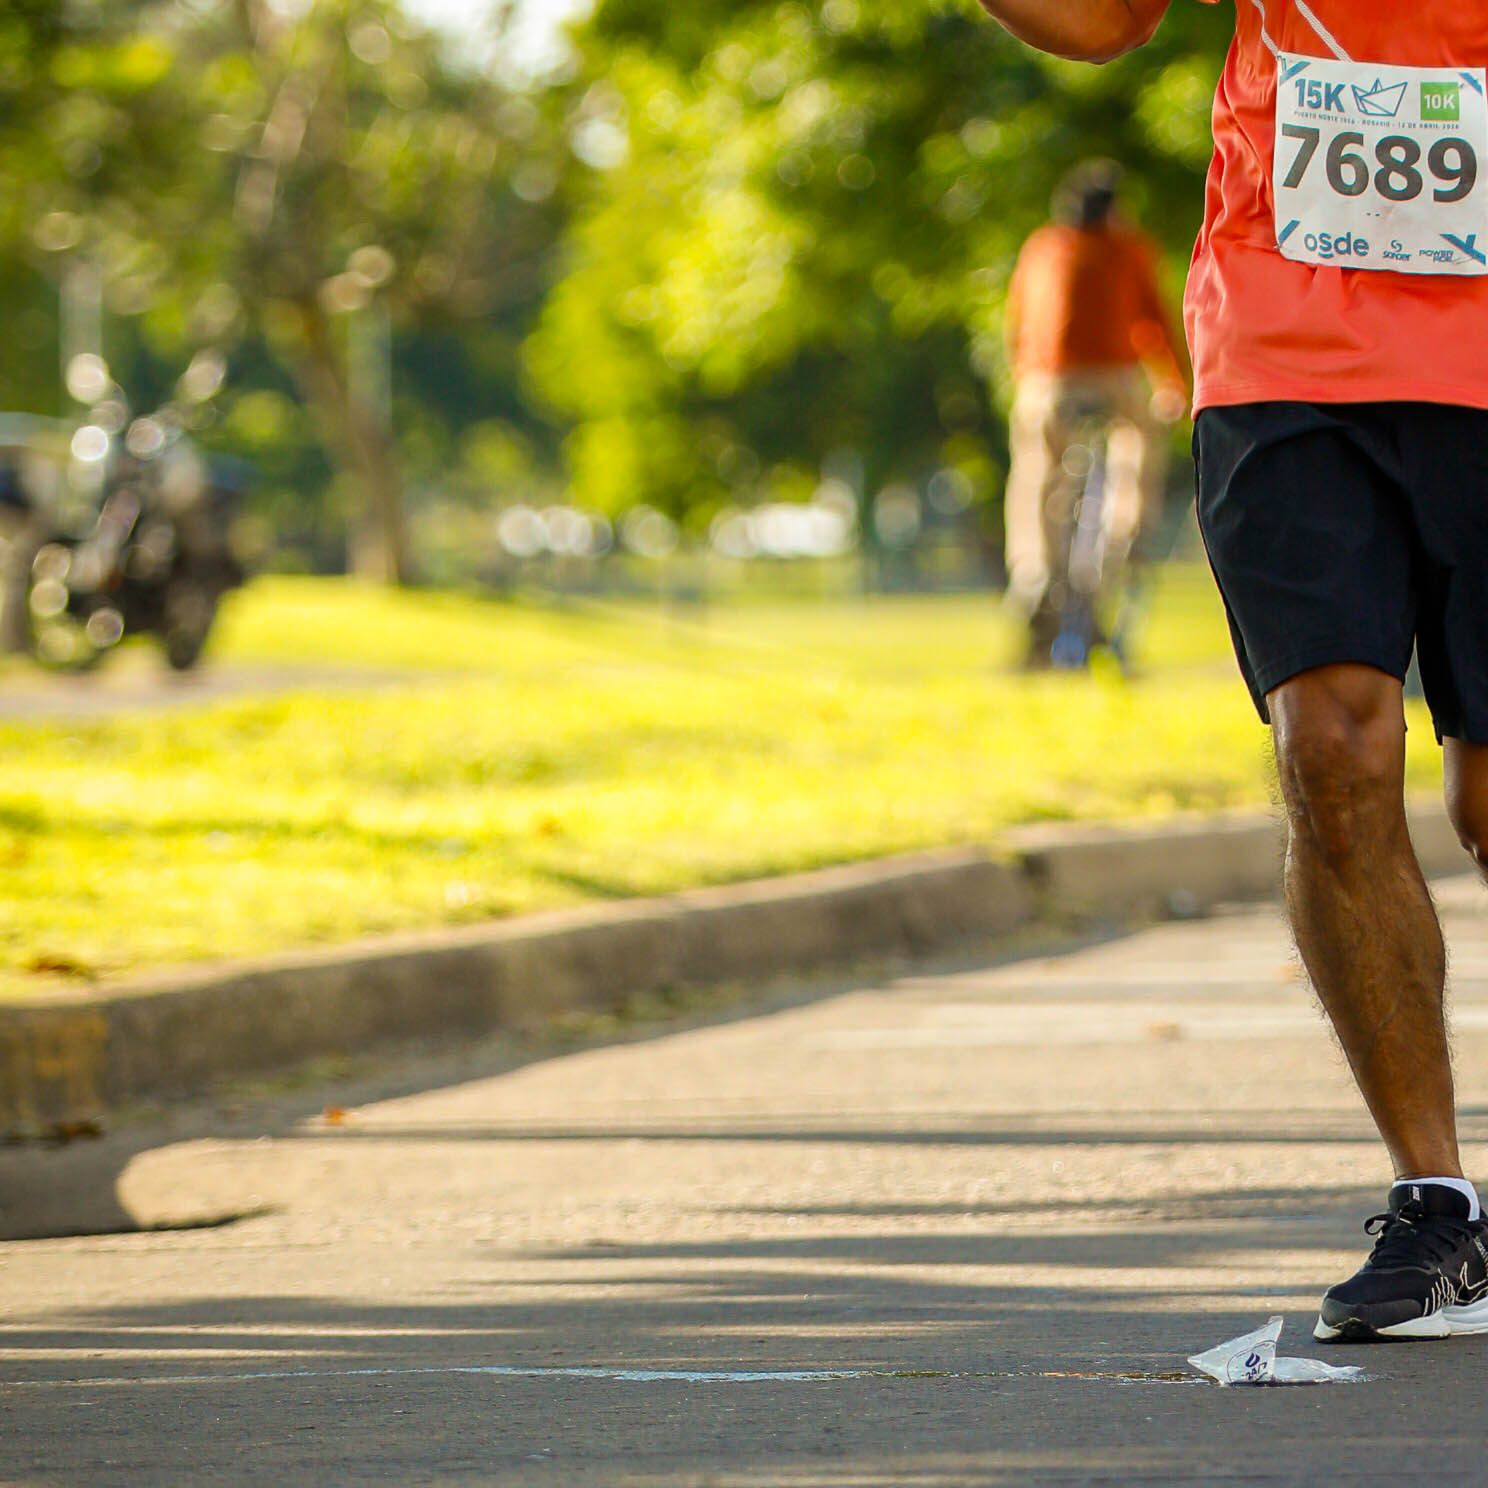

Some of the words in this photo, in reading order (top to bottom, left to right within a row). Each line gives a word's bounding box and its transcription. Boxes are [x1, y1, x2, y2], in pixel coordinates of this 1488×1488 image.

[1295, 78, 1346, 113] 15K
[1424, 94, 1455, 110] 10K
[1281, 123, 1478, 203] 7689
[1304, 232, 1369, 258] osde
